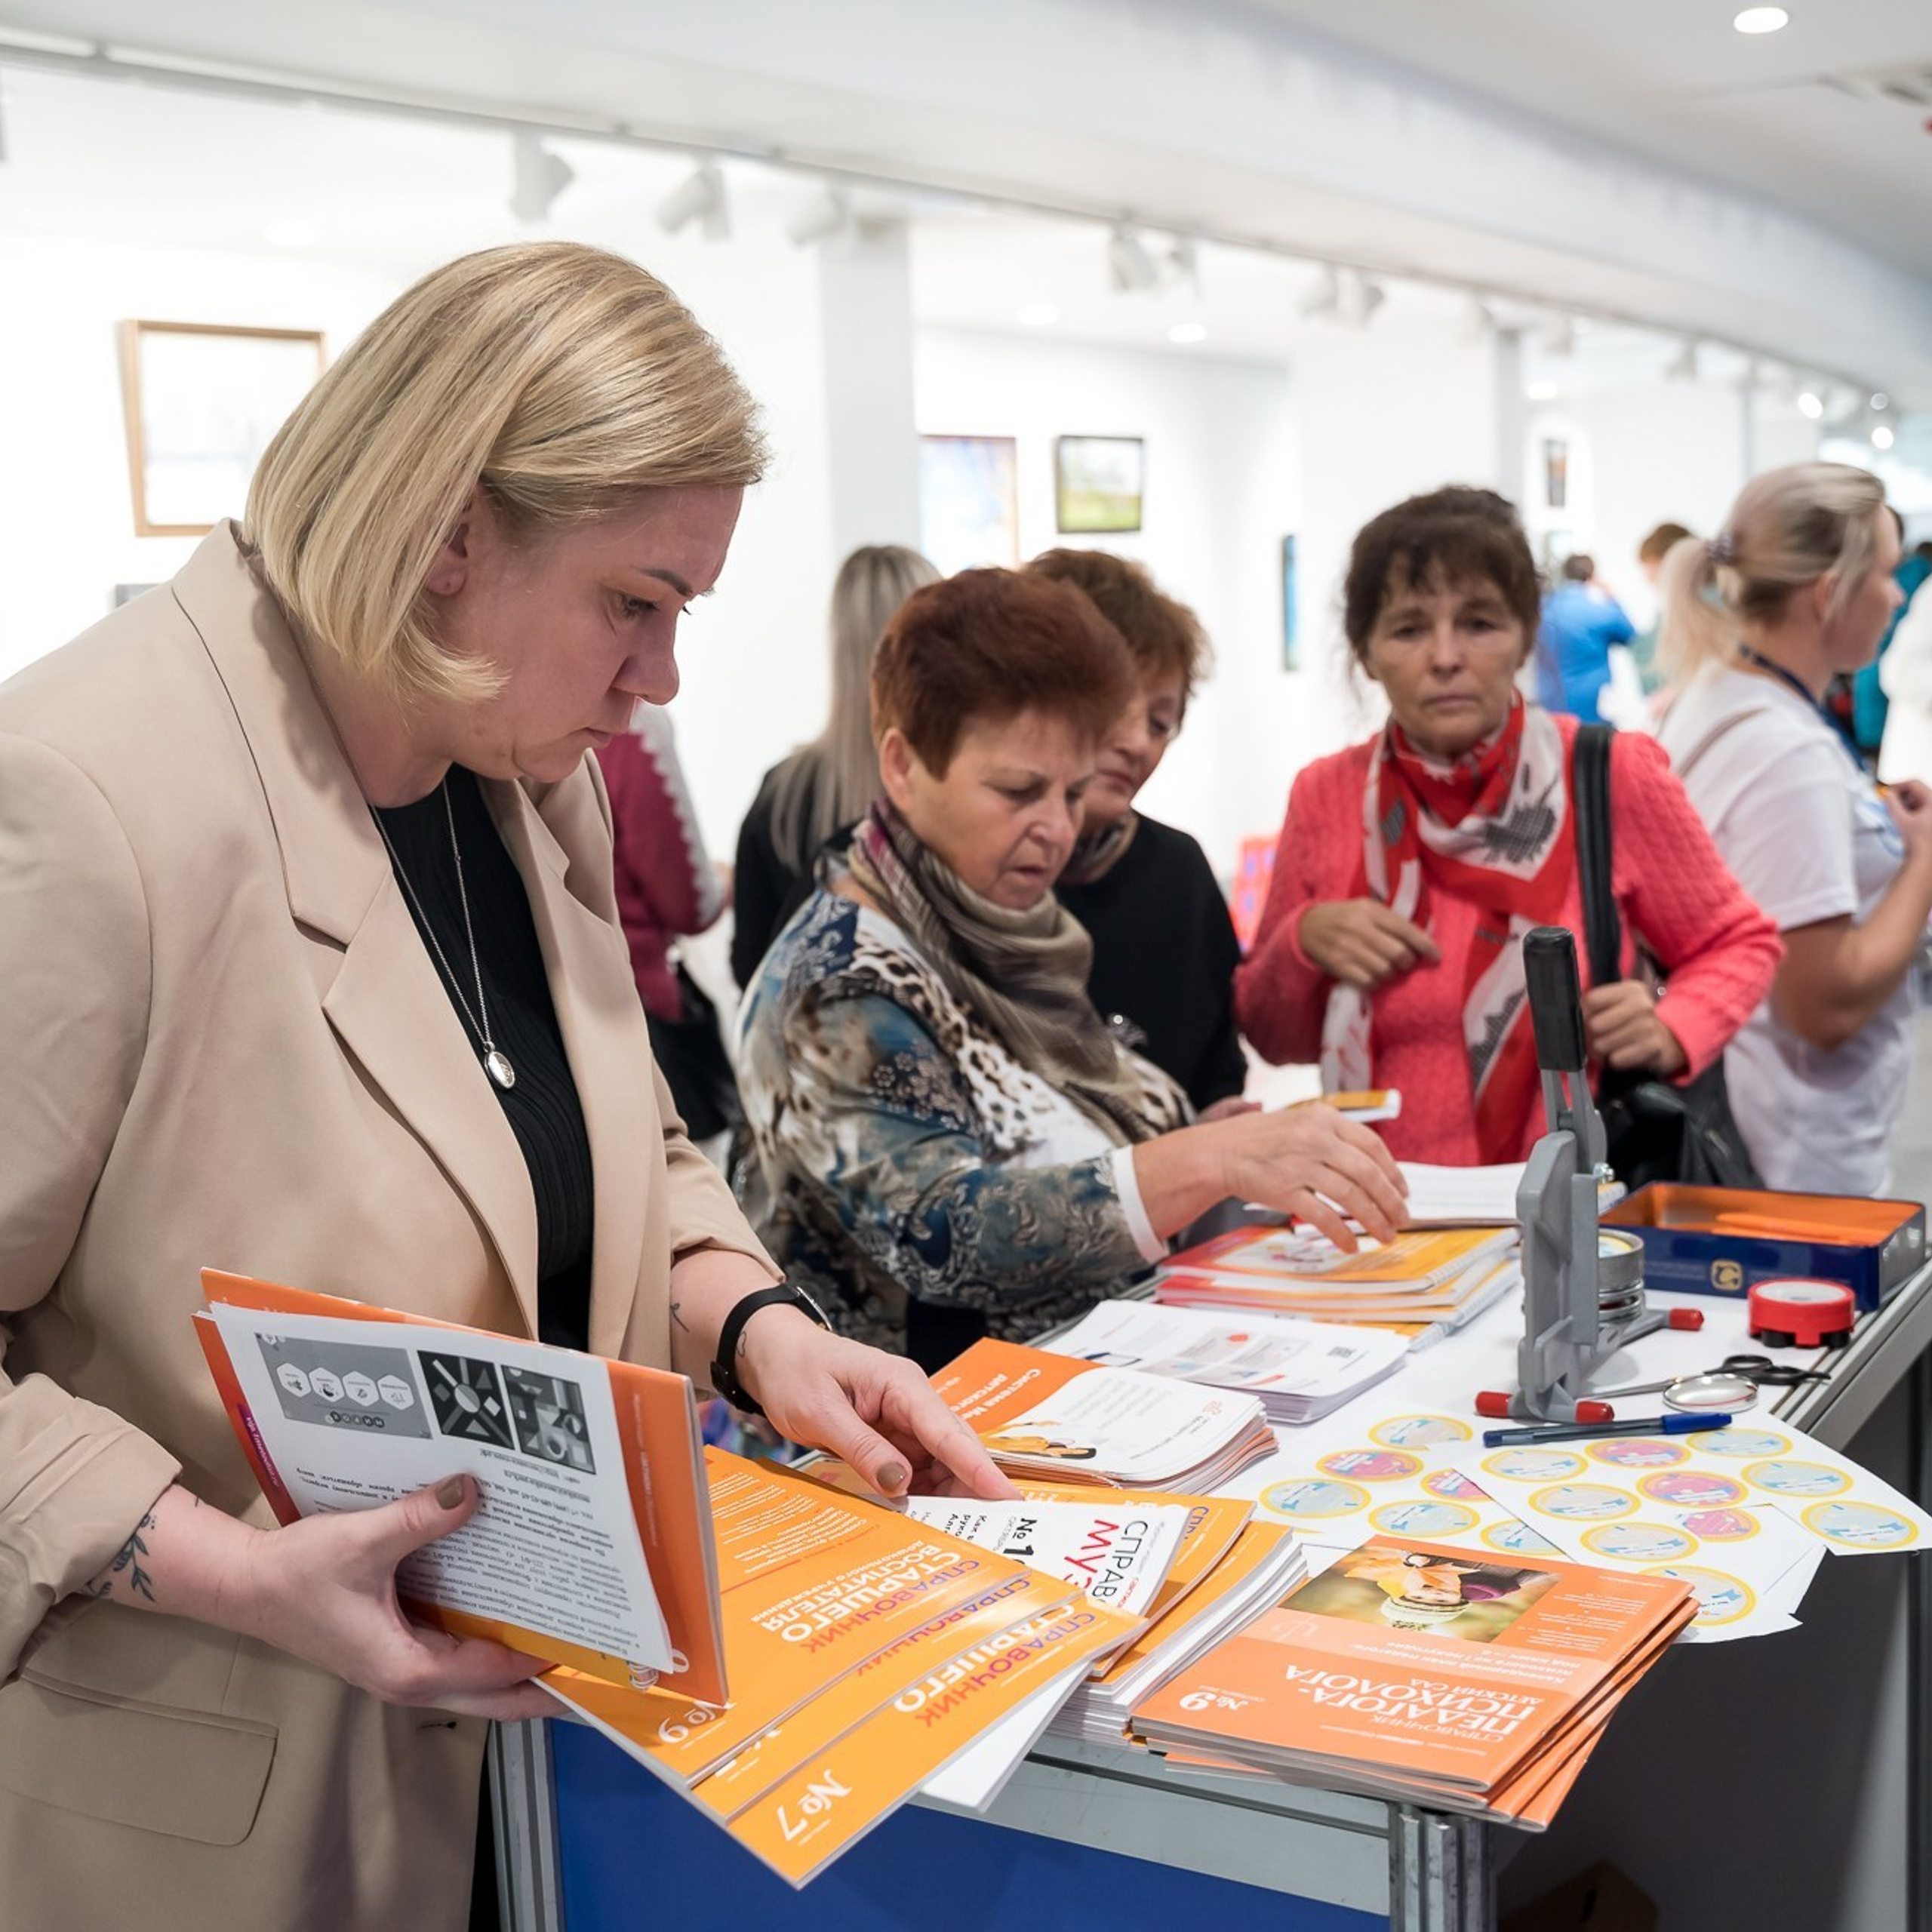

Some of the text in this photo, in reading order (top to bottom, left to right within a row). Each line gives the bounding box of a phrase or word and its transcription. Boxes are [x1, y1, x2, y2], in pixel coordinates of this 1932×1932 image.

[1184, 1506, 1209, 1540] СПР
[760, 1542, 941, 1633] ВОСПИТАТЕЛЯ
[779, 1547, 961, 1644] СТАРШЕГО
[1092, 1521, 1147, 1602] СПРАВ
[799, 1557, 980, 1655] СПРАВОЧНИК
[912, 1611, 1094, 1727] СПРАВОЧНИК
[1284, 1663, 1536, 1720] ПСИХОЛОГА
[1411, 1678, 1544, 1704] ДЕТСКИЙ САД
[1295, 1687, 1521, 1735] ПЕДАГОГА-
[1371, 1714, 1504, 1743] СПРАВОЧНИК
